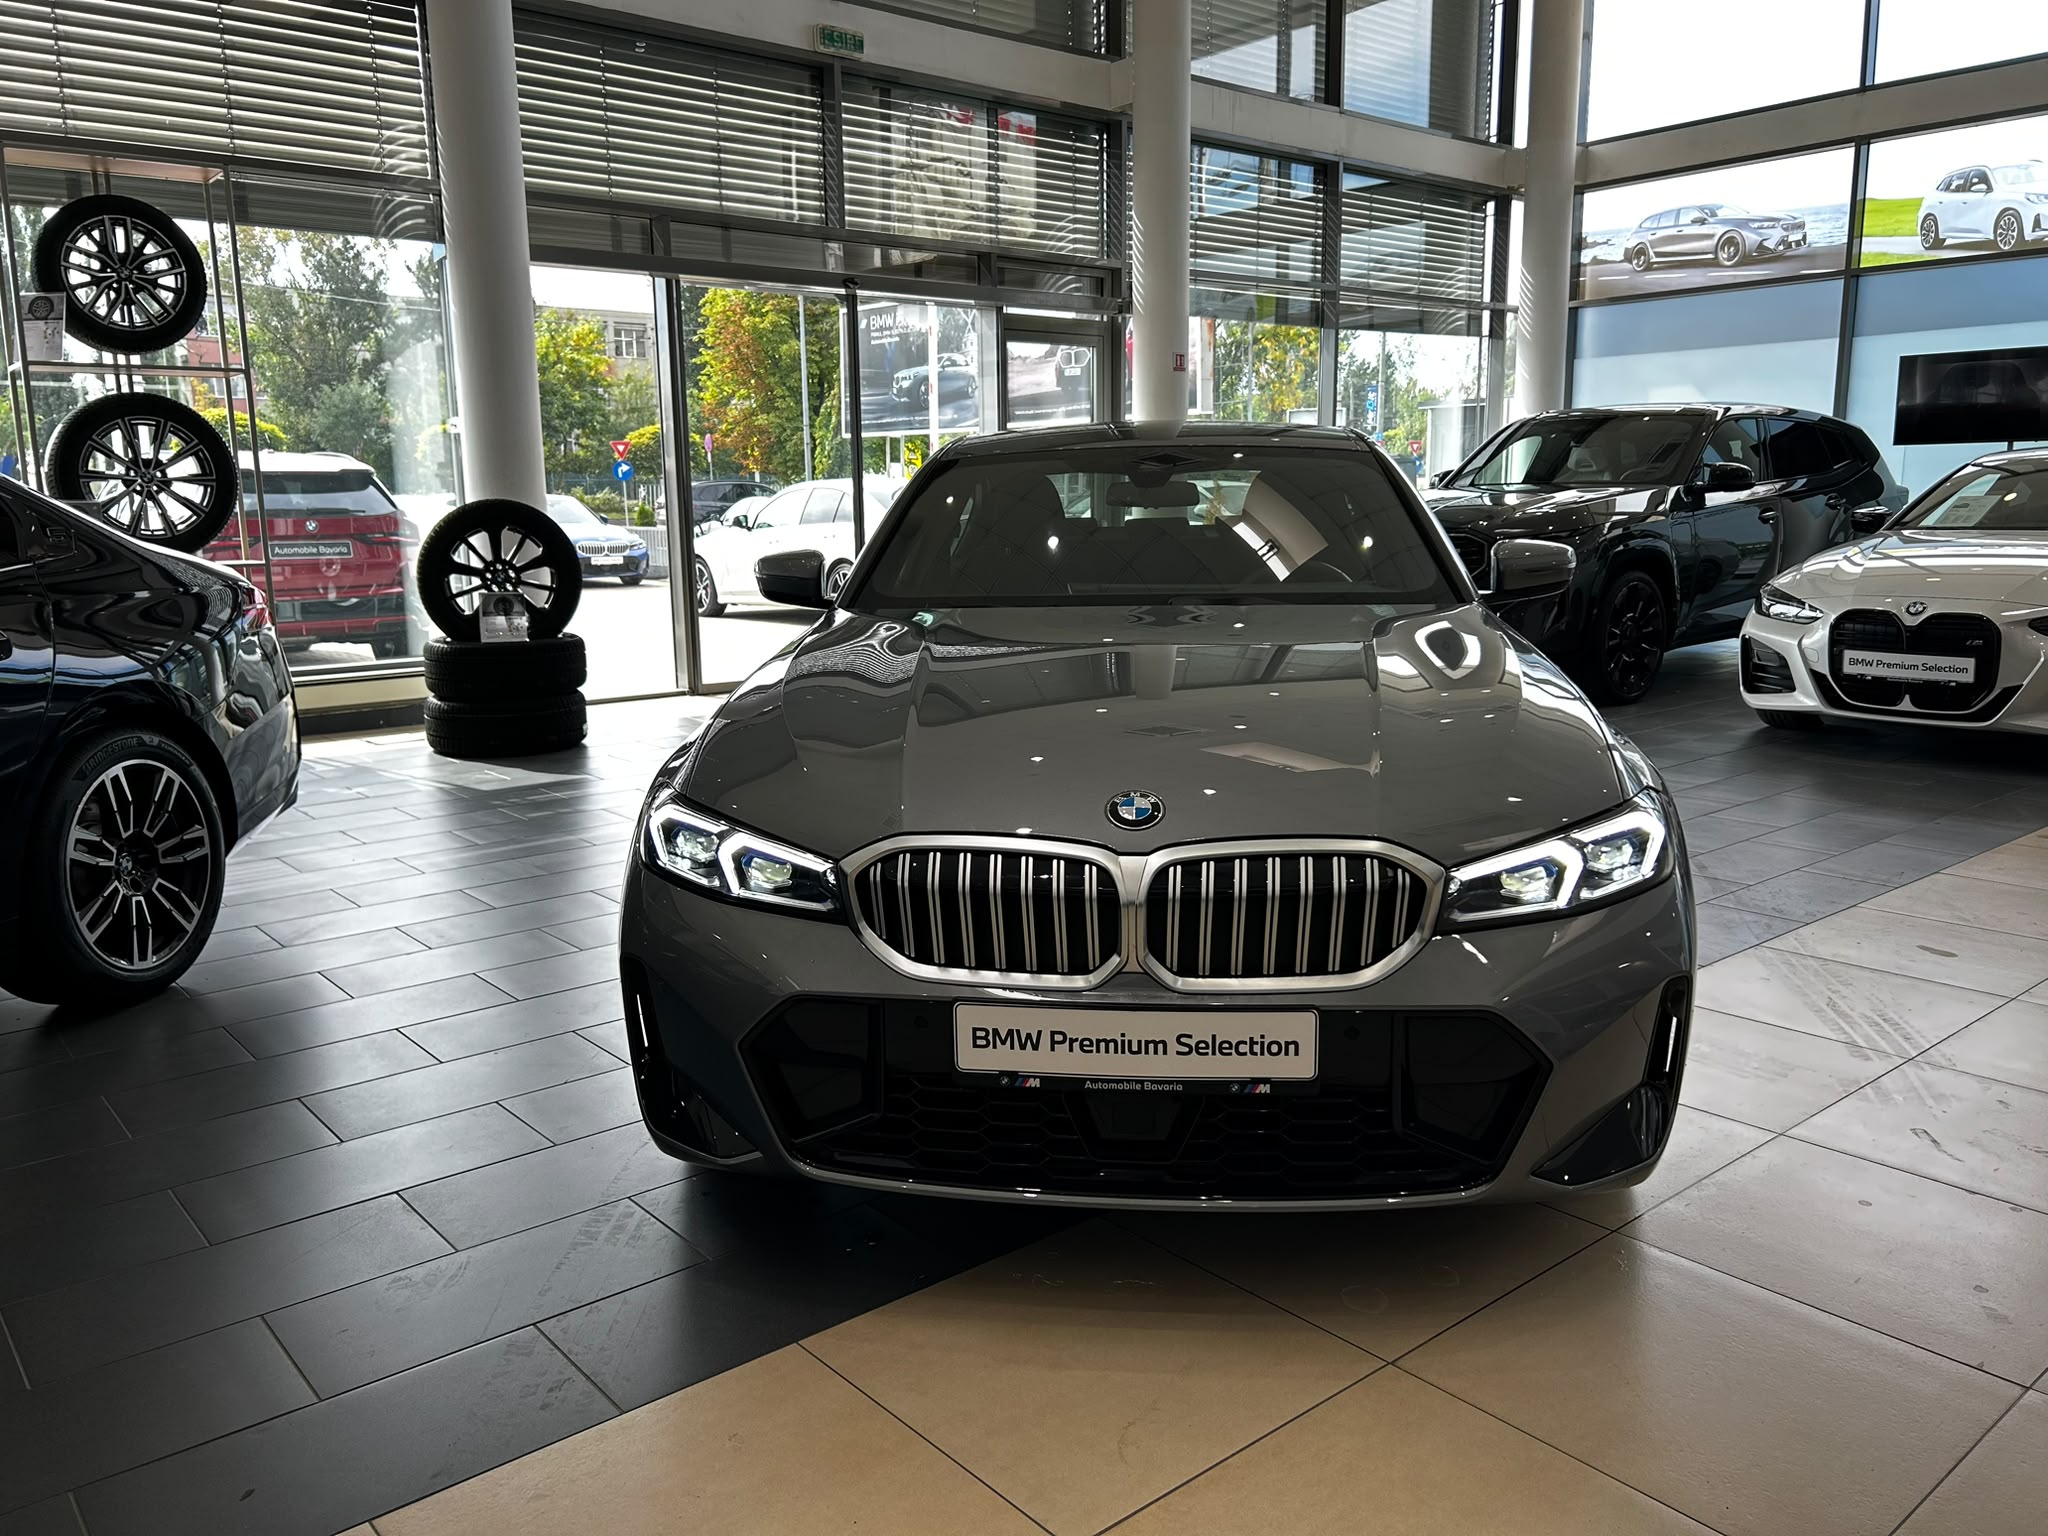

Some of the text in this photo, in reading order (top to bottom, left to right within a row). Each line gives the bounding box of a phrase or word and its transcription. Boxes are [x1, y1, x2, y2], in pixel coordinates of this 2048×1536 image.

[870, 313, 895, 330] BMW
[274, 545, 348, 554] Automobile Bavaria
[1849, 657, 1969, 674] BMW Premium Selection
[1114, 792, 1157, 803] BMW
[971, 1026, 1300, 1057] BMW Premium Selection
[1084, 1080, 1183, 1091] Automobile Bavaria
